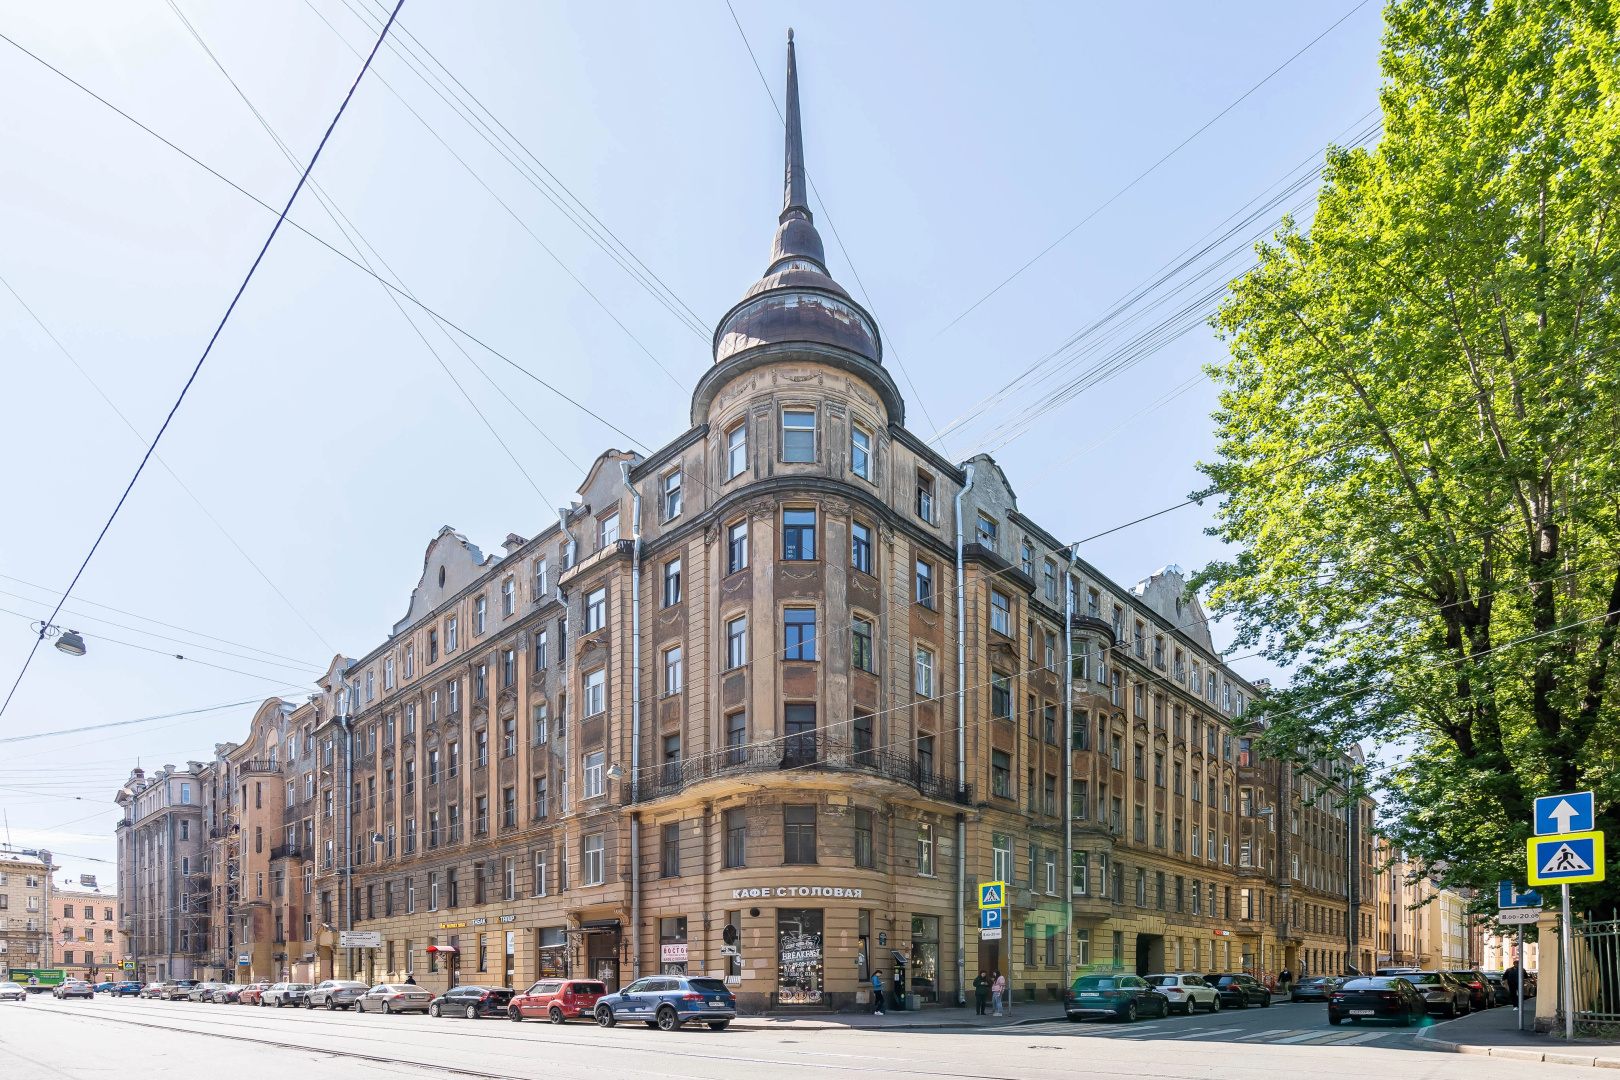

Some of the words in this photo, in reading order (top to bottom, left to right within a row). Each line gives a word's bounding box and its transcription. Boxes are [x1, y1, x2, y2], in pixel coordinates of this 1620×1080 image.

[732, 888, 770, 898] КАФЕ
[777, 886, 862, 898] СТОЛОВАЯ
[987, 911, 998, 926] P
[782, 948, 820, 961] BREAKFAST
